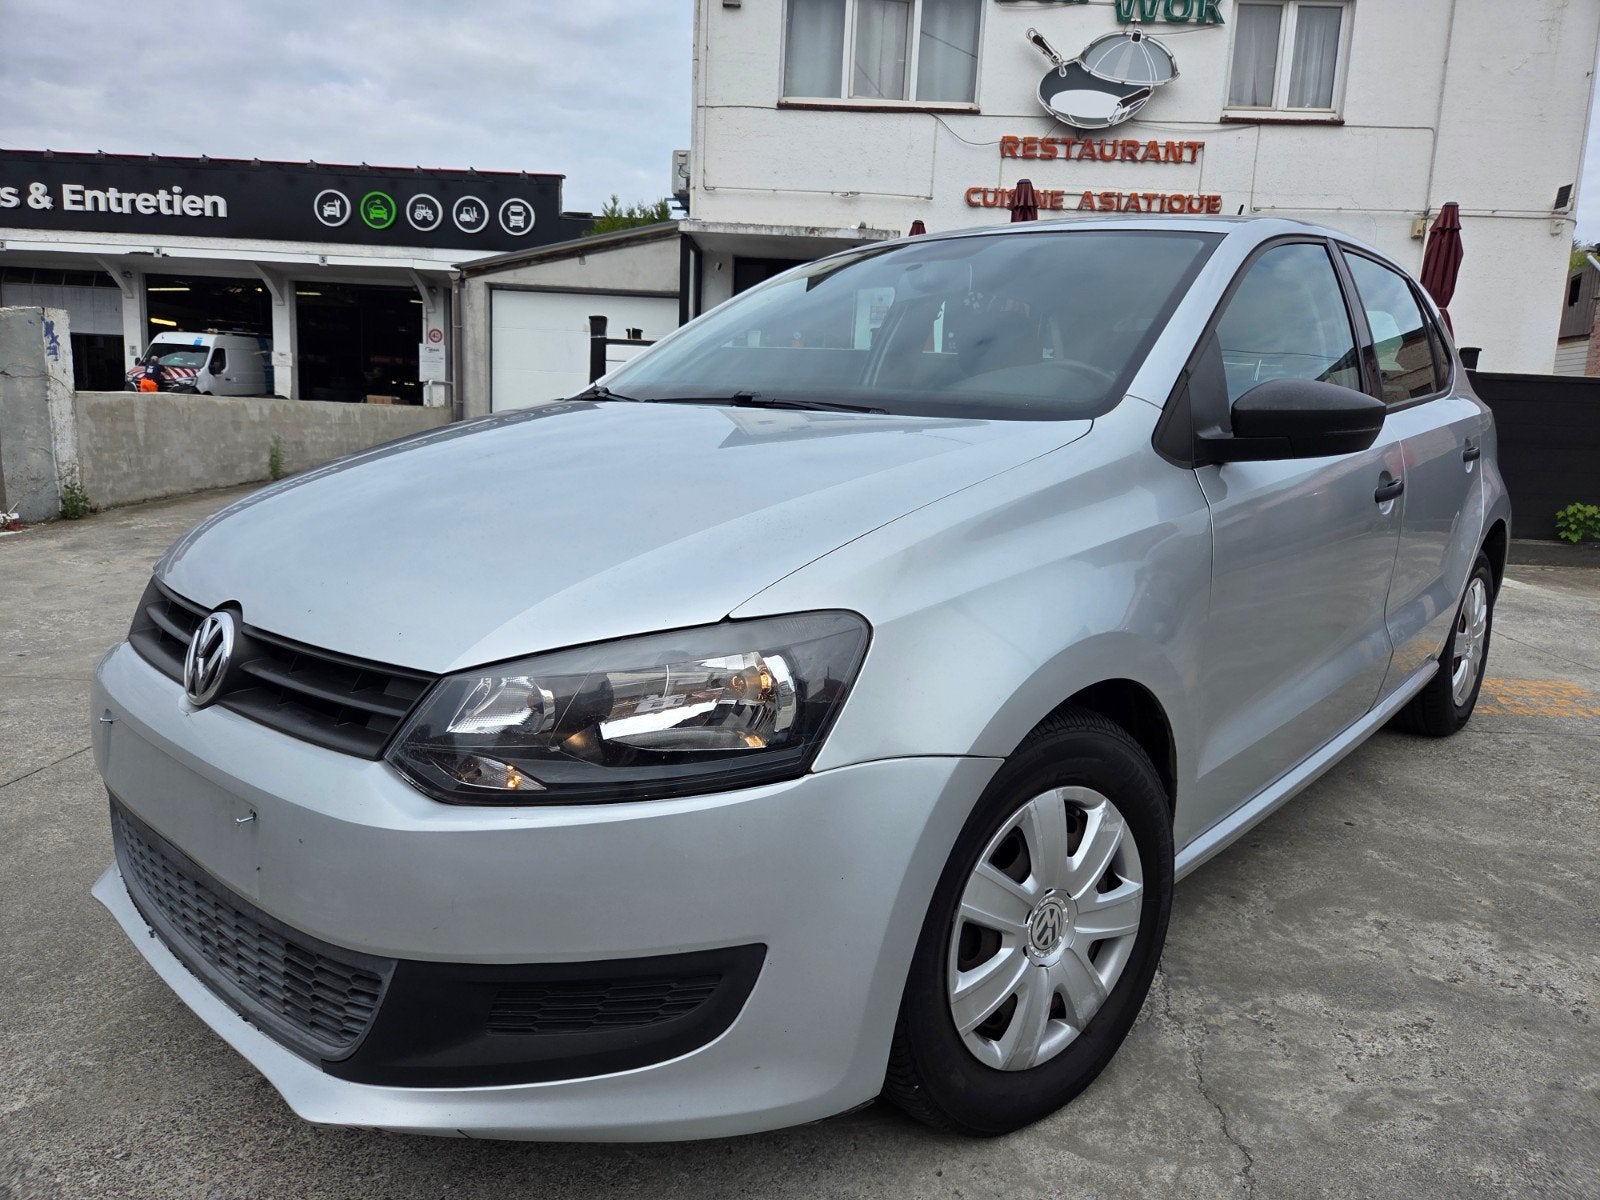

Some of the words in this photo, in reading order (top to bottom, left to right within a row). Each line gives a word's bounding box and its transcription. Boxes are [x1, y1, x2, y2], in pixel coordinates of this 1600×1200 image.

[1116, 0, 1225, 24] WOK
[1001, 136, 1205, 164] RESTAURANT
[0, 186, 20, 208] s
[27, 182, 54, 210] &
[62, 184, 228, 217] Entretien
[1077, 190, 1222, 214] ASIATIQUE
